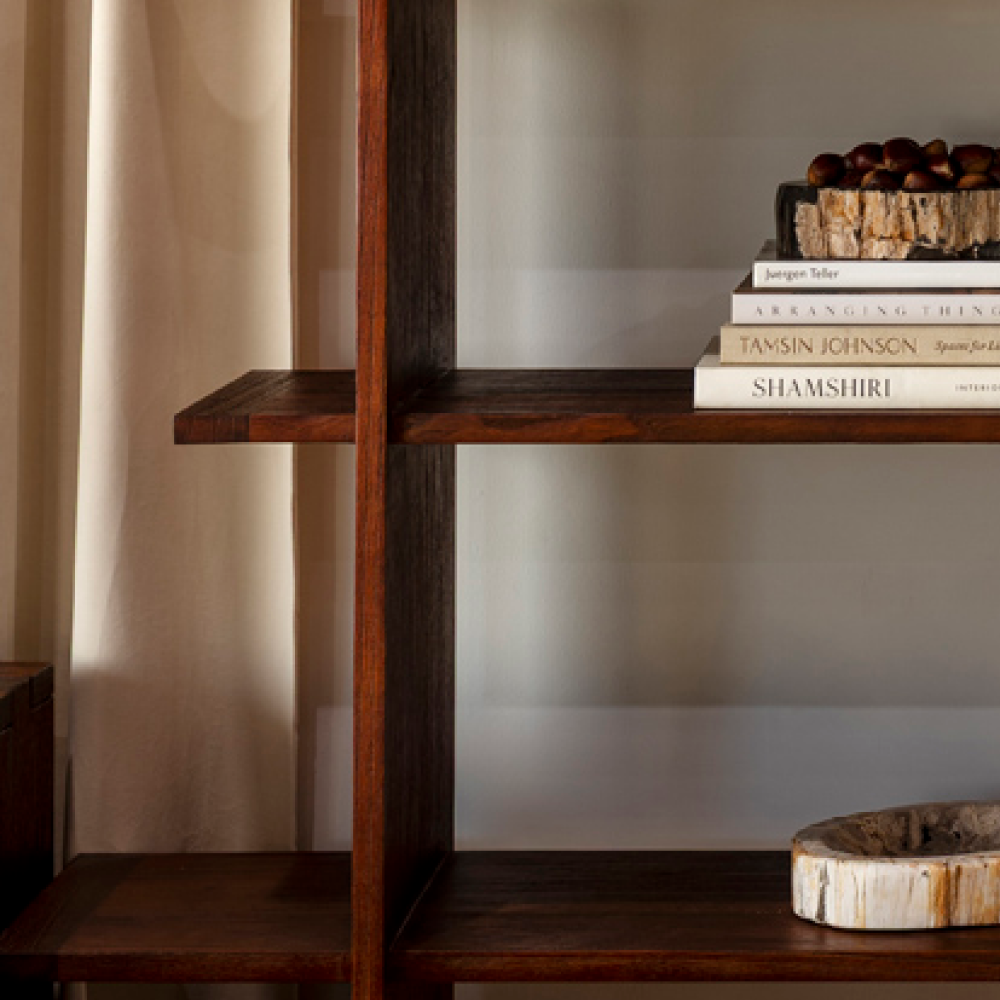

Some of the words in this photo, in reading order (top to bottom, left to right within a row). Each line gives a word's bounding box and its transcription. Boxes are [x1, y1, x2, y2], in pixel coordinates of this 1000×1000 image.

[765, 267, 806, 282] Juergen
[809, 267, 839, 279] Teller
[756, 306, 908, 316] ARRANGING
[739, 335, 814, 355] TAMSIN
[820, 335, 918, 355] JOHNSON
[751, 376, 892, 399] SHAMSHIRI
